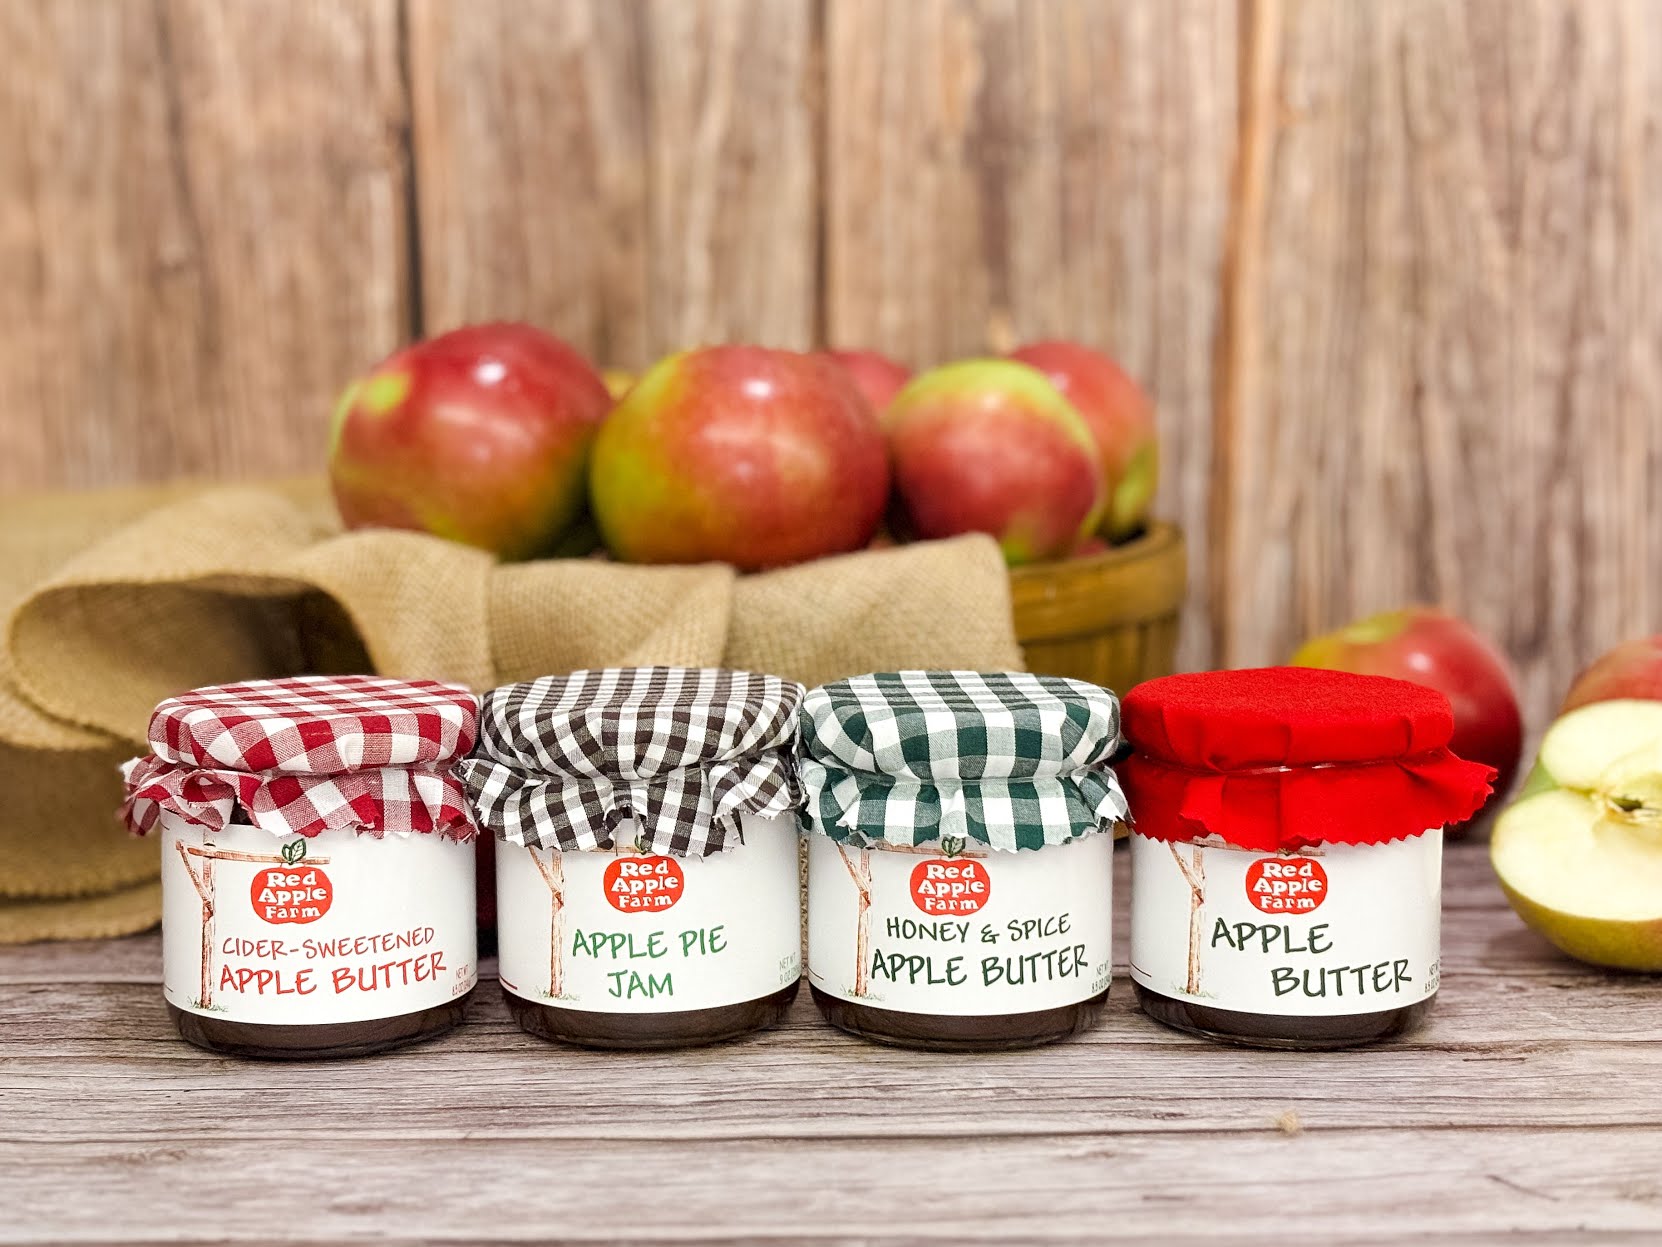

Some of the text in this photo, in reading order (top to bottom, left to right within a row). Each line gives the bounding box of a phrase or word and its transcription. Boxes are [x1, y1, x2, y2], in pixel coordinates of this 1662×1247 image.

[619, 859, 669, 877] Red
[926, 863, 975, 880] Red
[1262, 861, 1312, 878] Red
[266, 870, 317, 888] Red
[611, 876, 679, 895] Apple
[917, 879, 985, 897] Apple
[1253, 878, 1323, 896] Apple
[257, 887, 327, 906] Apple
[618, 894, 672, 909] Farm
[925, 897, 979, 911] Farm
[1260, 895, 1316, 910] Farm
[264, 905, 320, 920] Farm
[886, 913, 1071, 944] HONEY & SPICE
[1211, 917, 1333, 954] APPLE
[222, 927, 435, 960] CIDER-SWEETENED
[572, 925, 727, 959] APPLE PIE
[219, 951, 447, 996] APPLE BUTTER
[871, 944, 1088, 987] APPLE BUTTER
[607, 969, 674, 999] JAM
[1271, 959, 1412, 997] BUTTER
